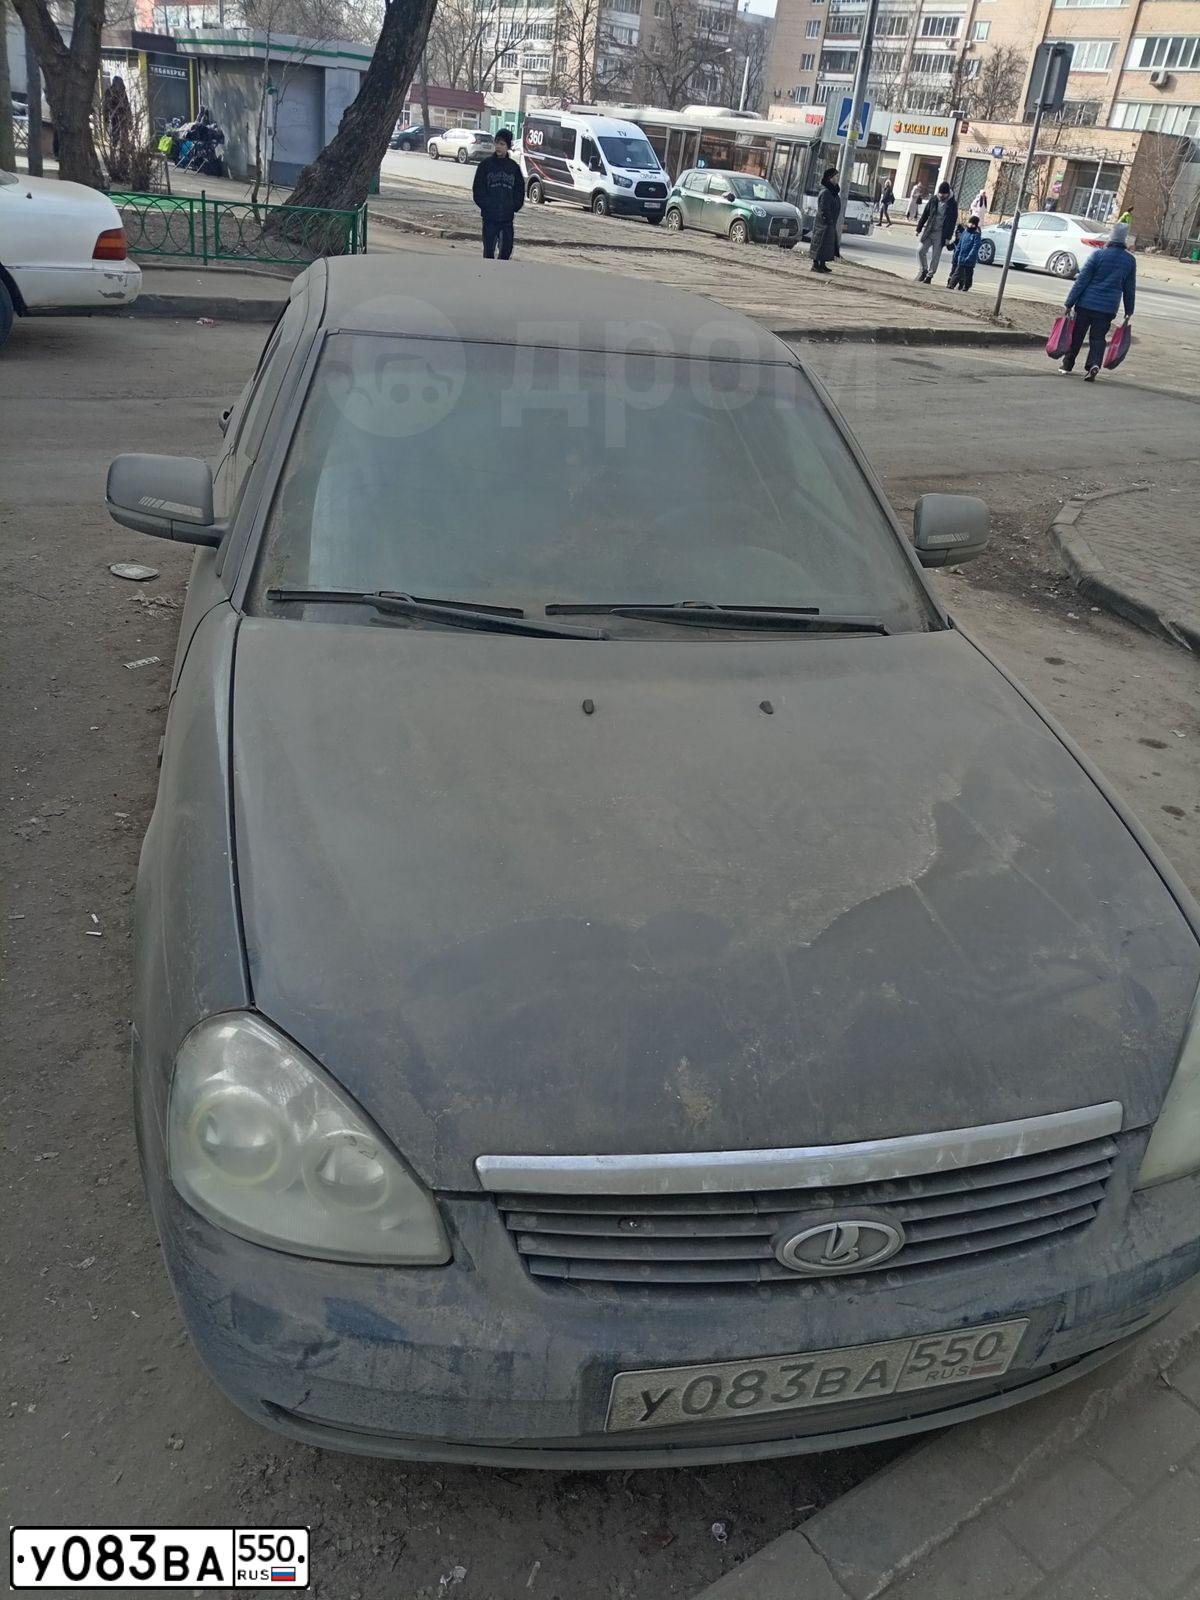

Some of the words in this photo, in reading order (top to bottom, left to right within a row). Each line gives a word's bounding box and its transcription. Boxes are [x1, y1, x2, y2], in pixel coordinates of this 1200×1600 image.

[528, 129, 544, 145] 360
[906, 1331, 1005, 1375] 550
[926, 1364, 969, 1382] RUS
